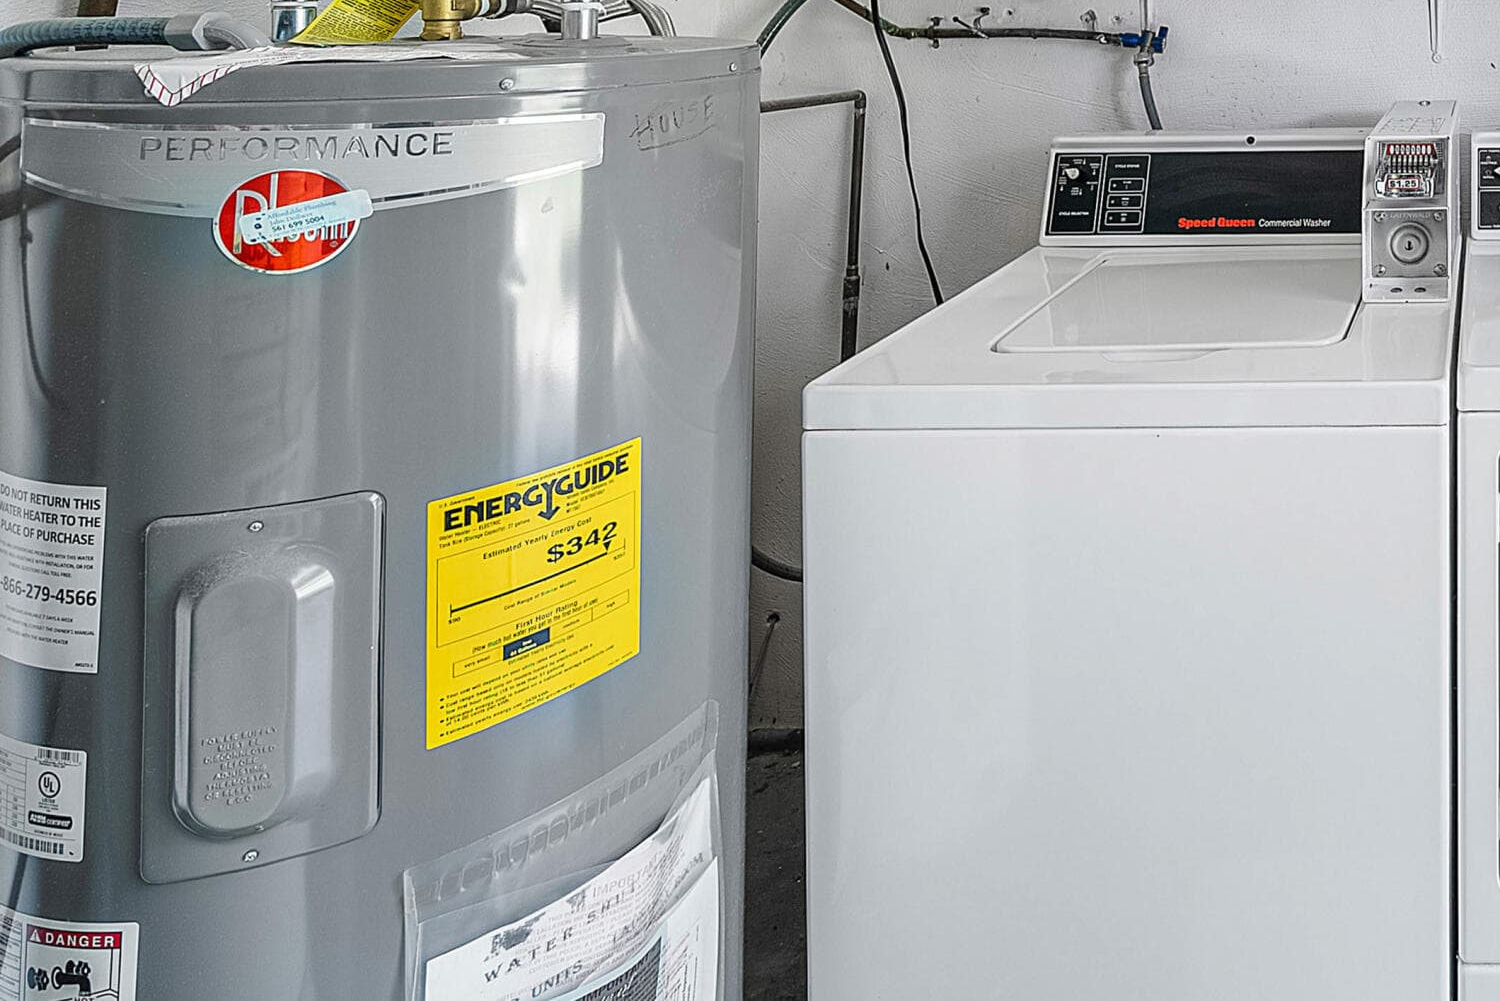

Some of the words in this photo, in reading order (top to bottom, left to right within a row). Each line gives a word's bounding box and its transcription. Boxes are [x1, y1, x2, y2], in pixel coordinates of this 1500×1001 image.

[140, 132, 454, 161] PERFORMANCE
[272, 224, 286, 233] 561
[288, 220, 303, 229] 699
[305, 215, 325, 225] 5004
[1178, 217, 1216, 229] Speed
[1217, 217, 1255, 228] Queen
[1258, 218, 1302, 228] Commercial
[1303, 218, 1332, 227] Washer
[0, 483, 10, 496] DO
[11, 488, 28, 502] NOT
[30, 492, 70, 509] RETURN
[73, 498, 101, 510] THIS
[444, 453, 629, 532] ENERGYGUIDE
[0, 519, 21, 536] PLACE
[23, 526, 35, 539] OF
[36, 529, 95, 546] PURCHASE
[23, 508, 58, 525] HEATER
[60, 514, 76, 526] TO
[78, 516, 101, 528] THE
[483, 540, 522, 561] Estimated
[524, 533, 548, 546] Yearly
[551, 525, 574, 538] Energy
[576, 517, 592, 527] Cost
[547, 521, 617, 564] $342
[515, 618, 533, 630] First
[535, 611, 553, 622] Hour
[556, 600, 578, 614] Rating
[45, 932, 114, 948] DANGER
[483, 925, 573, 985] WATER
[531, 959, 583, 999] UNITS
